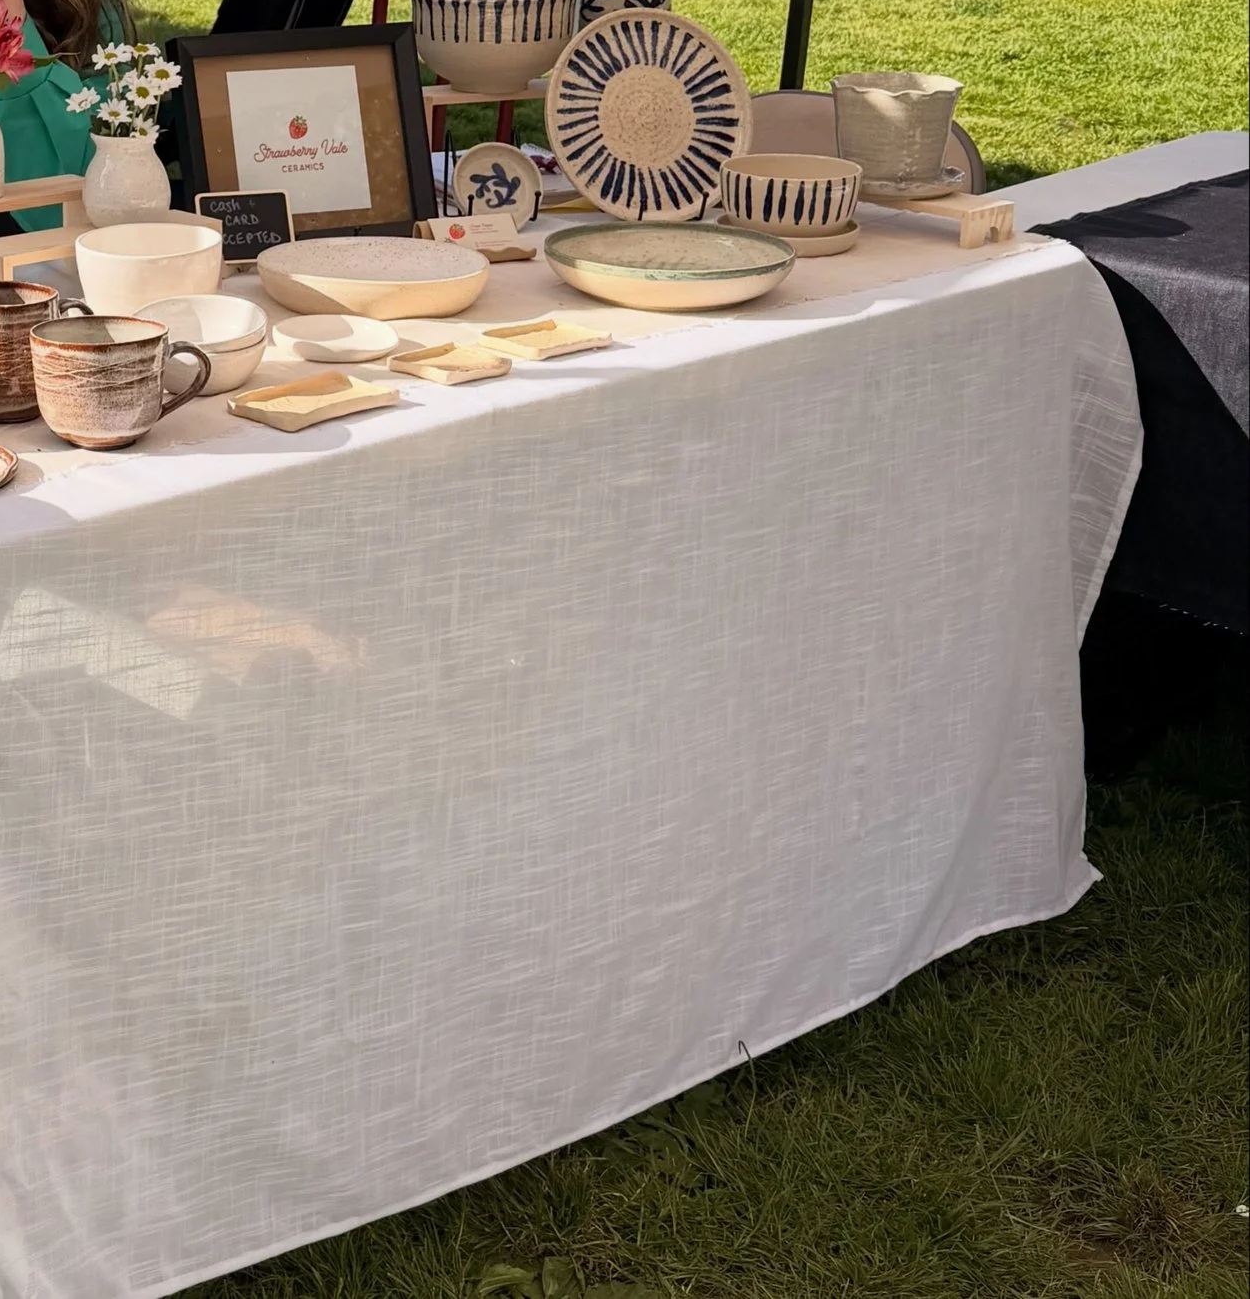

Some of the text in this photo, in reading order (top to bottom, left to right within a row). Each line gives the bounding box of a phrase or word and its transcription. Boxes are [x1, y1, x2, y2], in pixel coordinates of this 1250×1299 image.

[253, 138, 349, 163] Strawberry Vale
[281, 162, 325, 173] CERAMICS
[225, 213, 260, 227] CARD
[222, 230, 282, 245] CCEPTED
